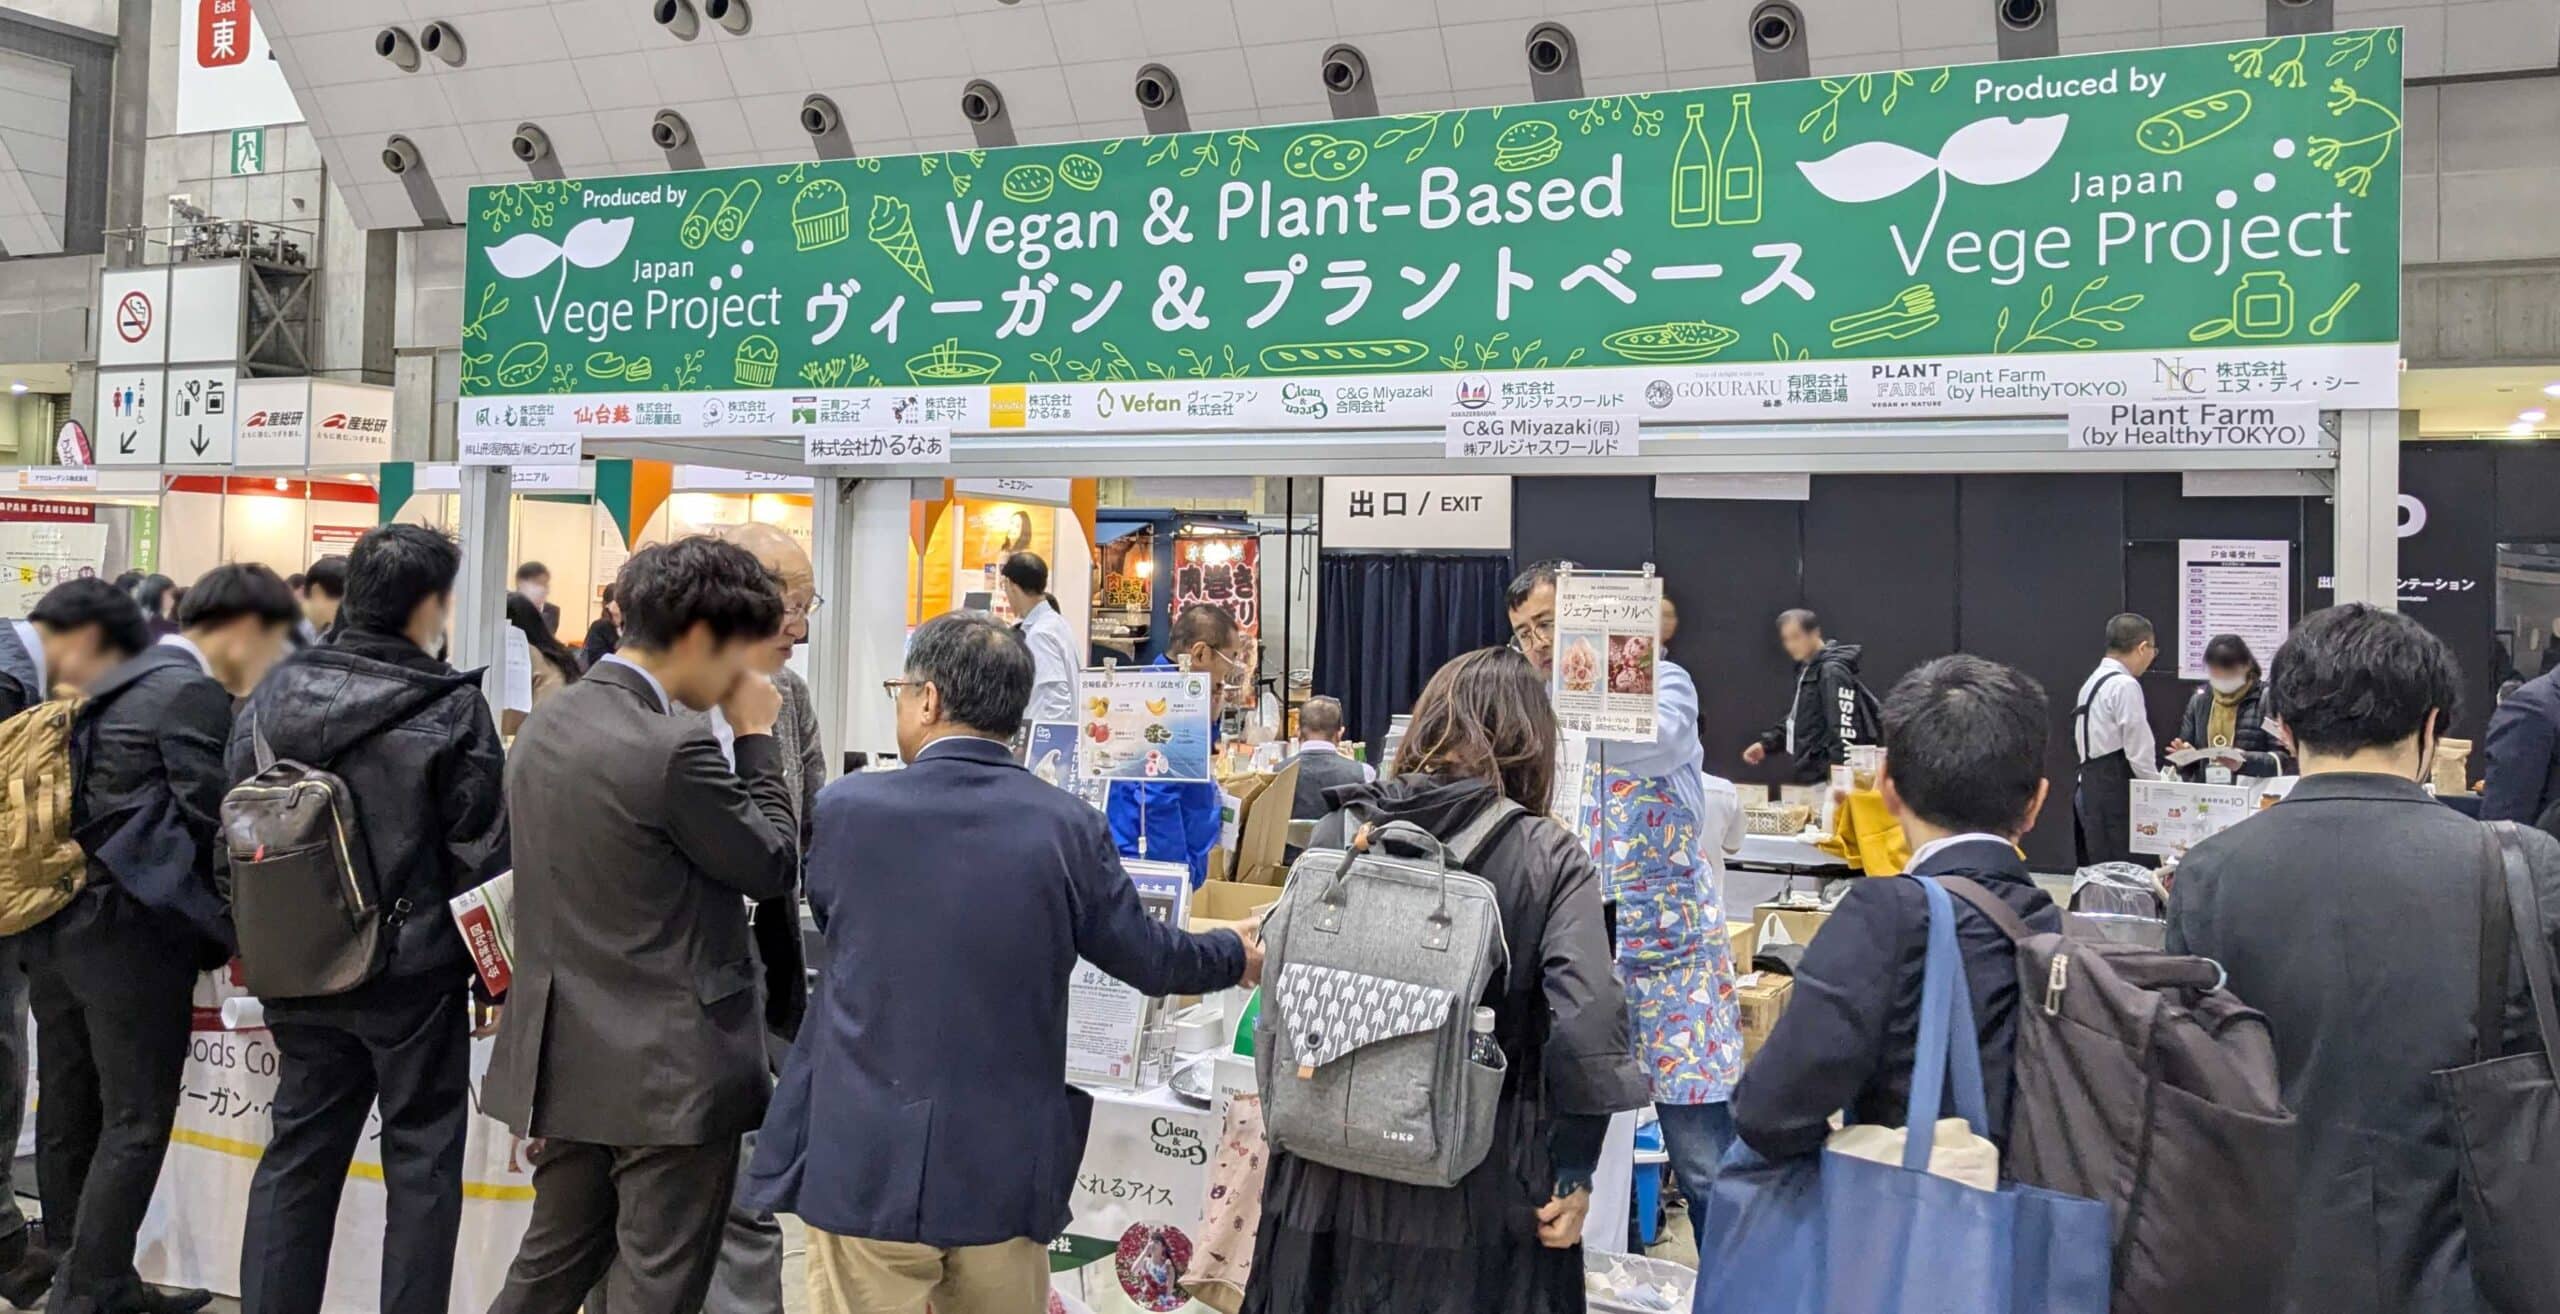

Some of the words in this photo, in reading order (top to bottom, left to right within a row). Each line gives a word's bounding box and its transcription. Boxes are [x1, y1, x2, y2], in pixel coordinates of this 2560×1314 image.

[214, 0, 236, 14] East
[211, 18, 237, 59] 東
[1975, 70, 2118, 104] Produced
[2129, 68, 2167, 97] by
[2070, 170, 2183, 203] Japan
[583, 186, 661, 208] Produced
[667, 186, 687, 206] by
[947, 200, 1118, 269] Vegan
[1143, 187, 1193, 245] &
[1218, 153, 1623, 240] Plant-Based
[1890, 223, 2071, 285] Vege
[2099, 190, 2352, 277] Project
[633, 260, 694, 283] Japan
[806, 272, 1122, 345] ヴィーガン
[1152, 264, 1210, 331] &
[1244, 242, 1815, 329] プラントベース
[534, 295, 633, 342] Vege
[646, 277, 782, 338] Project
[1871, 363, 1942, 379] PLANT
[1946, 368, 1993, 384] Plant
[1998, 368, 2046, 383] Farm
[2216, 361, 2287, 377] 株式会社
[1501, 381, 1555, 395] 株式会社
[1676, 379, 1782, 398] GOKURAKU
[1787, 373, 1849, 389] 有限会社
[2216, 376, 2361, 393] エヌ・ディ・シー
[1187, 389, 1259, 403] ヴィーファン
[1282, 382, 1321, 401] Clean
[1336, 386, 1370, 400] C&G
[1373, 384, 1433, 402] Miyazaki
[1787, 388, 1849, 403] 林酒造場
[1877, 382, 1935, 398] FARM
[1946, 384, 1975, 402] (by
[1980, 380, 2128, 400] HealthyTOKYO)
[519, 403, 555, 415] 株式会社
[635, 402, 673, 413] 株式会社
[728, 400, 766, 412] 株式会社
[925, 396, 968, 409] 株式会社
[1028, 394, 1073, 407] 株式会社
[1120, 394, 1182, 413] Vefan
[1336, 401, 1386, 414] 合同会社
[1501, 394, 1625, 410] アルジャスワールド
[1911, 400, 1941, 408] NATURE
[728, 412, 776, 424] シュウエイ
[820, 411, 861, 423] 株式会社
[1187, 403, 1235, 416] 株式会社
[1285, 401, 1329, 420] Green
[2111, 404, 2189, 426] Plant
[2200, 404, 2275, 425] Farm
[267, 410, 304, 427] 産総研
[347, 416, 388, 433] 産総研
[1462, 420, 1504, 436] C&G
[2082, 426, 2118, 446] (by
[2125, 425, 2306, 446] HealthyTOKYO)
[810, 434, 943, 457] 株式会社かるなぁ
[31, 504, 89, 515] STANDARD
[1349, 490, 1407, 518] 出口
[1417, 490, 1431, 516] /
[1441, 496, 1483, 511] EXIT
[1177, 562, 1255, 600] 肉巻き
[1563, 601, 1654, 620] ジェラート・ソルベ
[245, 1041, 282, 1077] Co
[1150, 1116, 1199, 1141] Clean
[1172, 1137, 1182, 1146] &
[1154, 1142, 1208, 1165] Green
